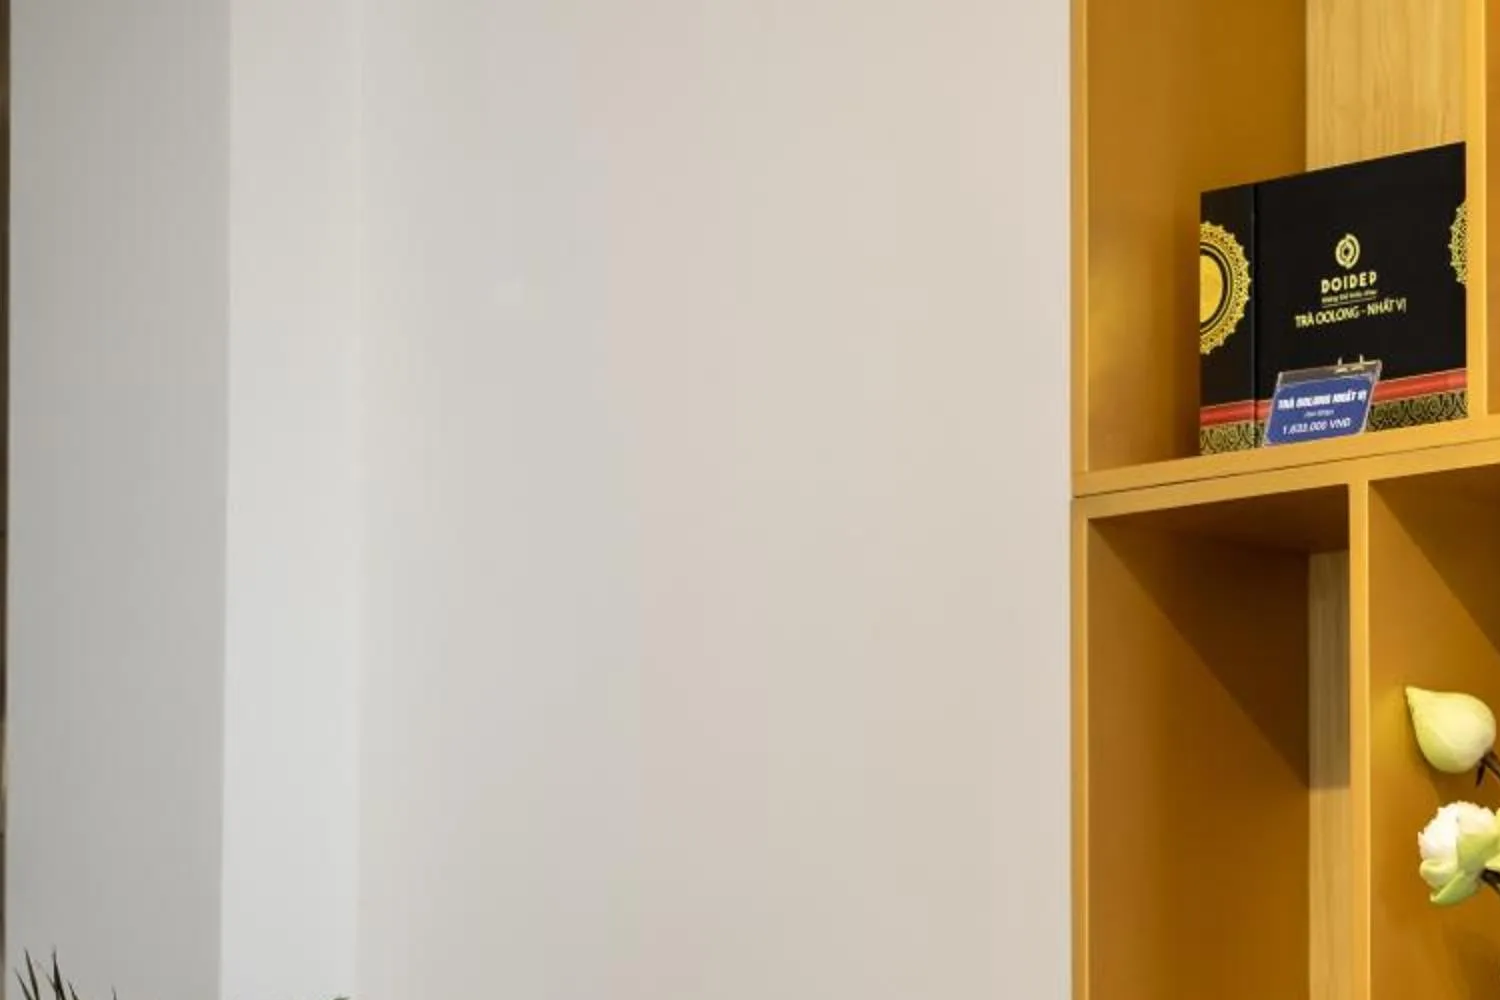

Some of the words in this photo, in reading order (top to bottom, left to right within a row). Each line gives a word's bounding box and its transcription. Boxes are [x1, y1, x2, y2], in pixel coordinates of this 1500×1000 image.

[1321, 270, 1377, 294] DOIDEP
[1295, 312, 1315, 329] TRÀ
[1315, 305, 1360, 325] OOLONG
[1366, 297, 1394, 317] NHẤT
[1396, 297, 1407, 313] VỊ
